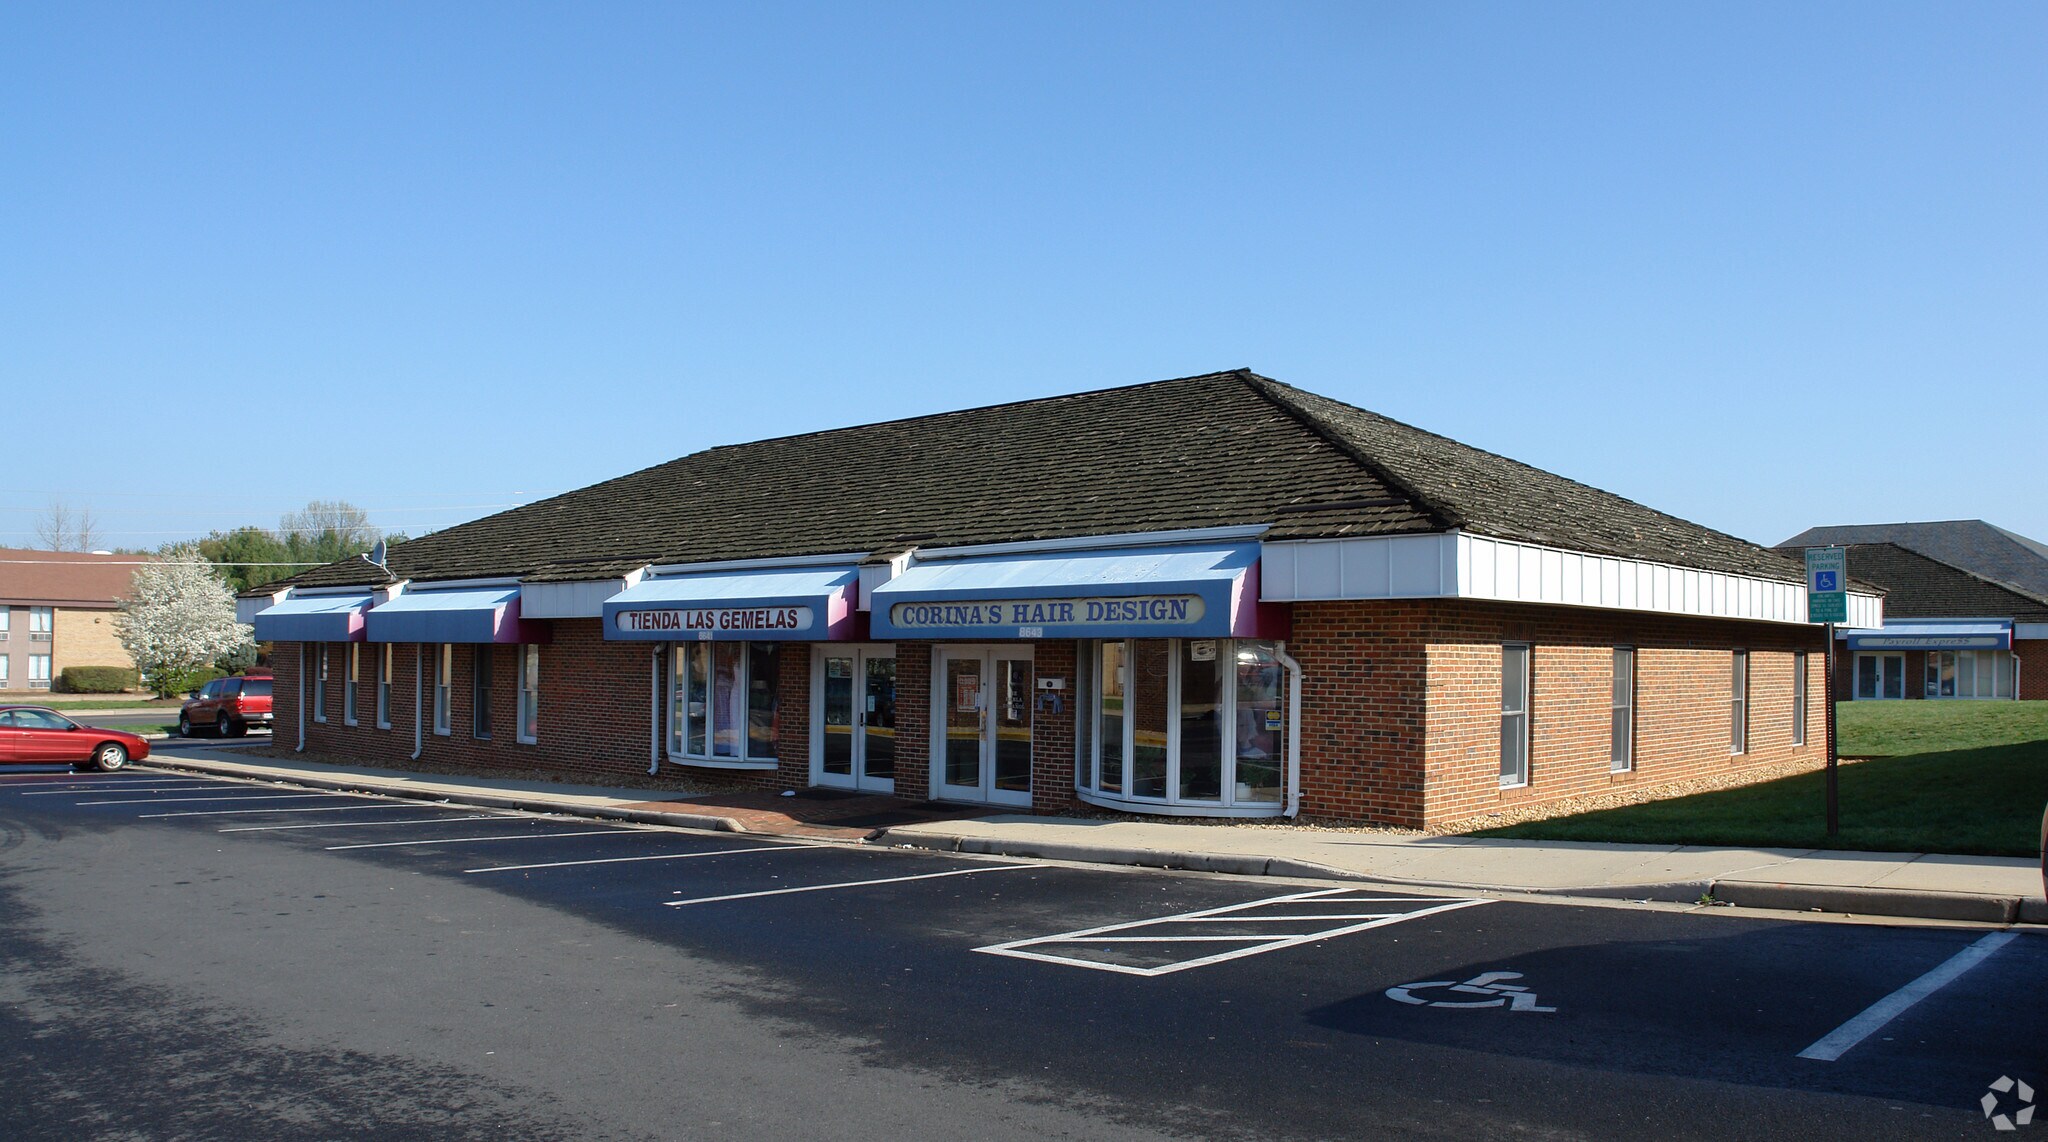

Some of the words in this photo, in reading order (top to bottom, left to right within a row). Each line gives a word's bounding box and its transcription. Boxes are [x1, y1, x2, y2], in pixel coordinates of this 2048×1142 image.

[1808, 552, 1843, 561] RESERVED
[1811, 562, 1840, 571] PARKING
[902, 604, 1002, 625] CORINA'S
[1011, 602, 1075, 624] HAIR
[1086, 598, 1190, 622] DESIGN
[629, 611, 681, 630] TIENDA
[686, 610, 715, 629] LAS
[719, 609, 798, 630] GEMELAS
[1019, 627, 1043, 638] 8643
[1883, 637, 1921, 646] Payroll
